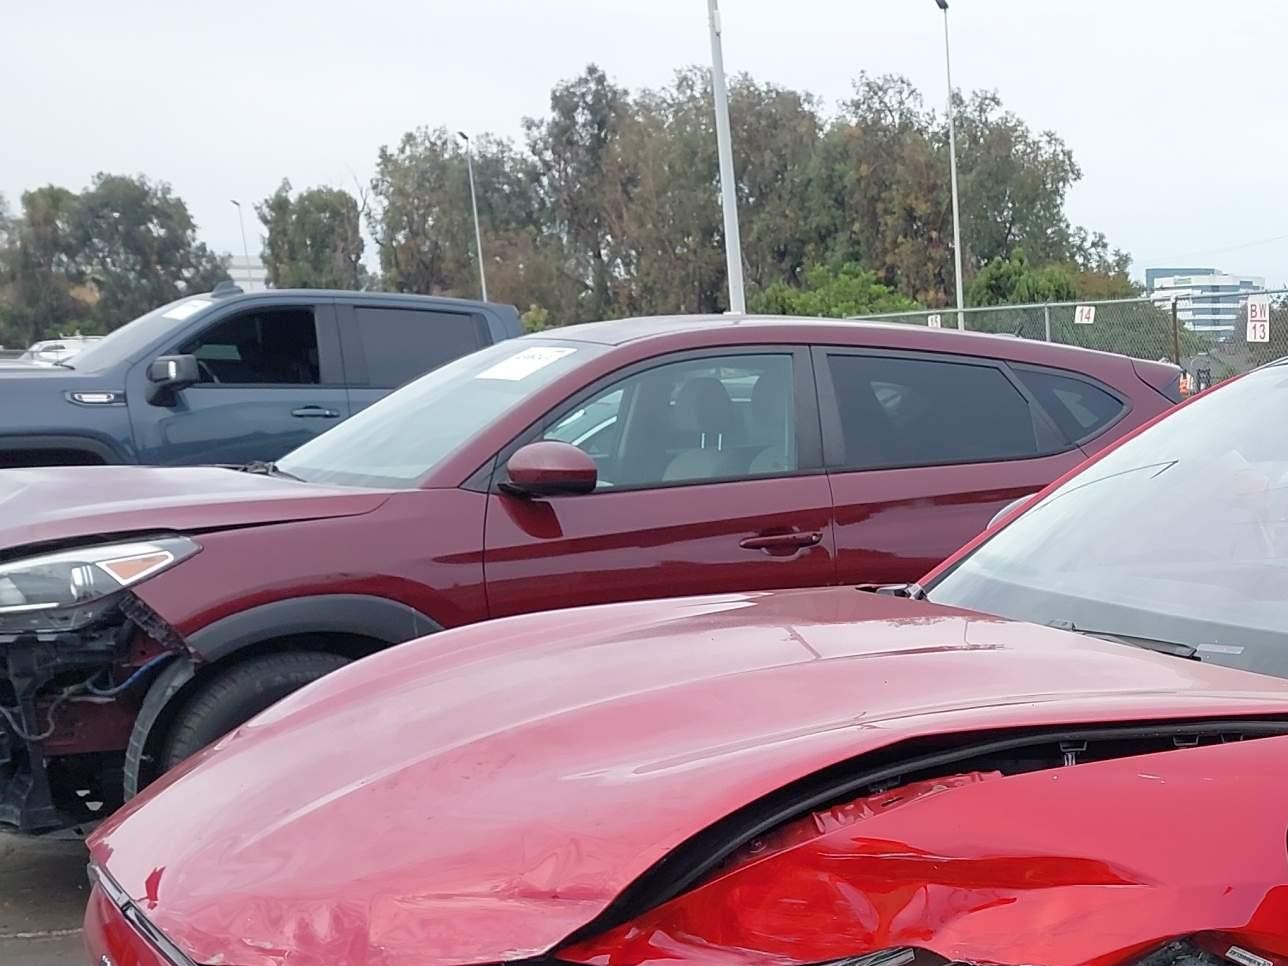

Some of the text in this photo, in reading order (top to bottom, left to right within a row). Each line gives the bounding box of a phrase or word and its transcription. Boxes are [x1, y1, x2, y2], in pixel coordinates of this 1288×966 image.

[1079, 307, 1092, 323] 14
[1250, 303, 1267, 319] BW
[1252, 323, 1266, 340] 13
